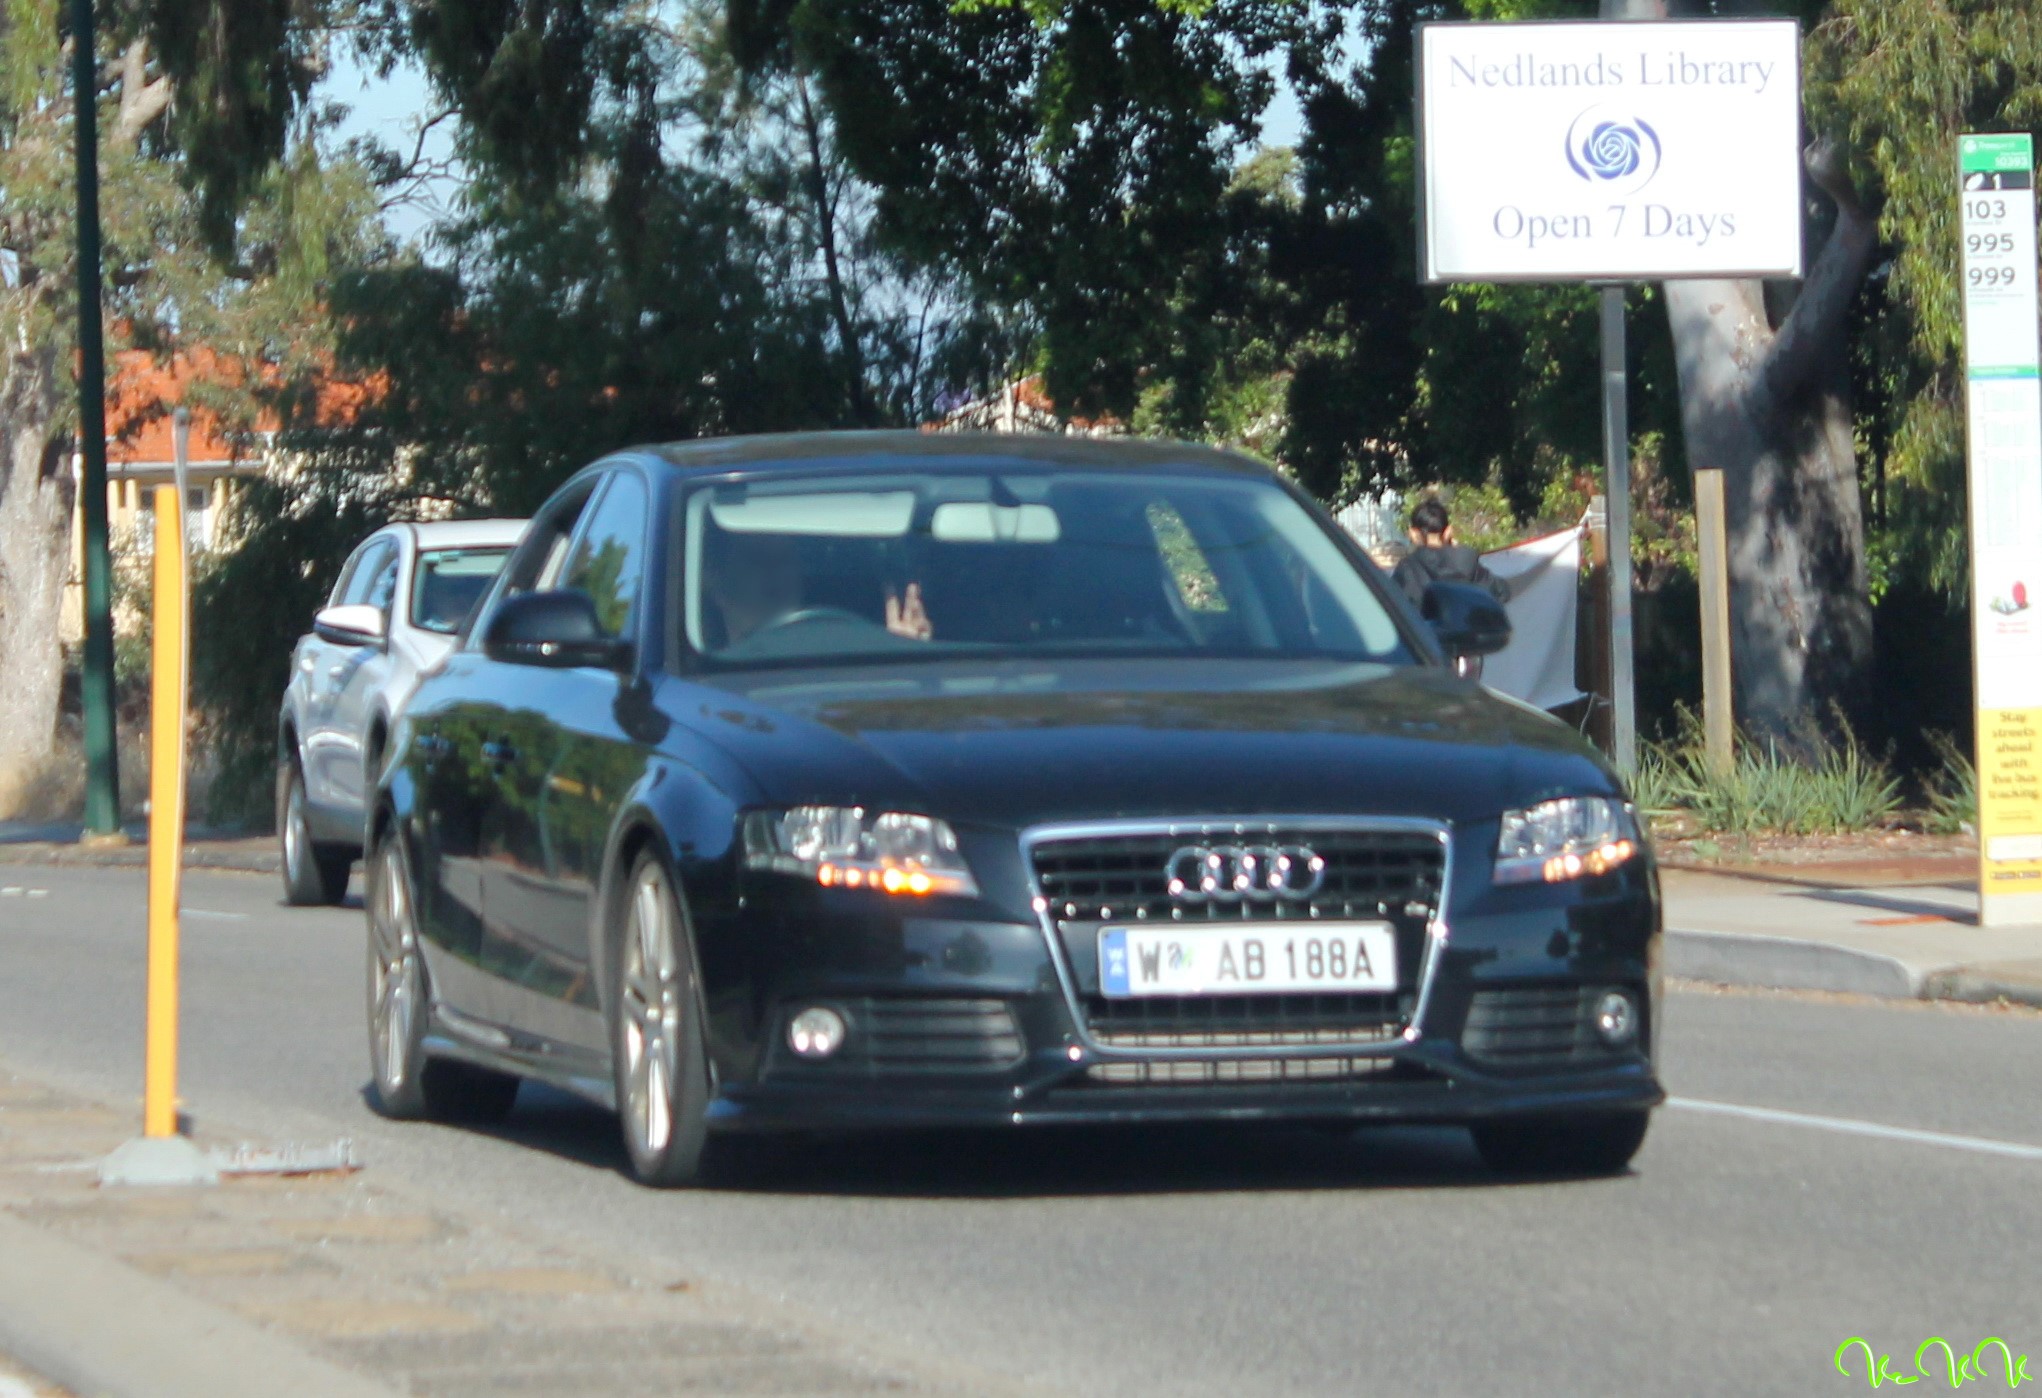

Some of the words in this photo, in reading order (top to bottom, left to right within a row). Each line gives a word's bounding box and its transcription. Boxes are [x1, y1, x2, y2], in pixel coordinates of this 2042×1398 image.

[1449, 53, 1623, 87] Nedlands
[1640, 51, 1775, 93] Library
[1966, 200, 2006, 219] 103
[1492, 205, 1591, 249] Open
[1606, 205, 1626, 238] 7
[1643, 204, 1736, 246] Days
[1967, 233, 2014, 253] 995
[1968, 266, 2016, 286] 999
[1284, 938, 1374, 979] 188A
